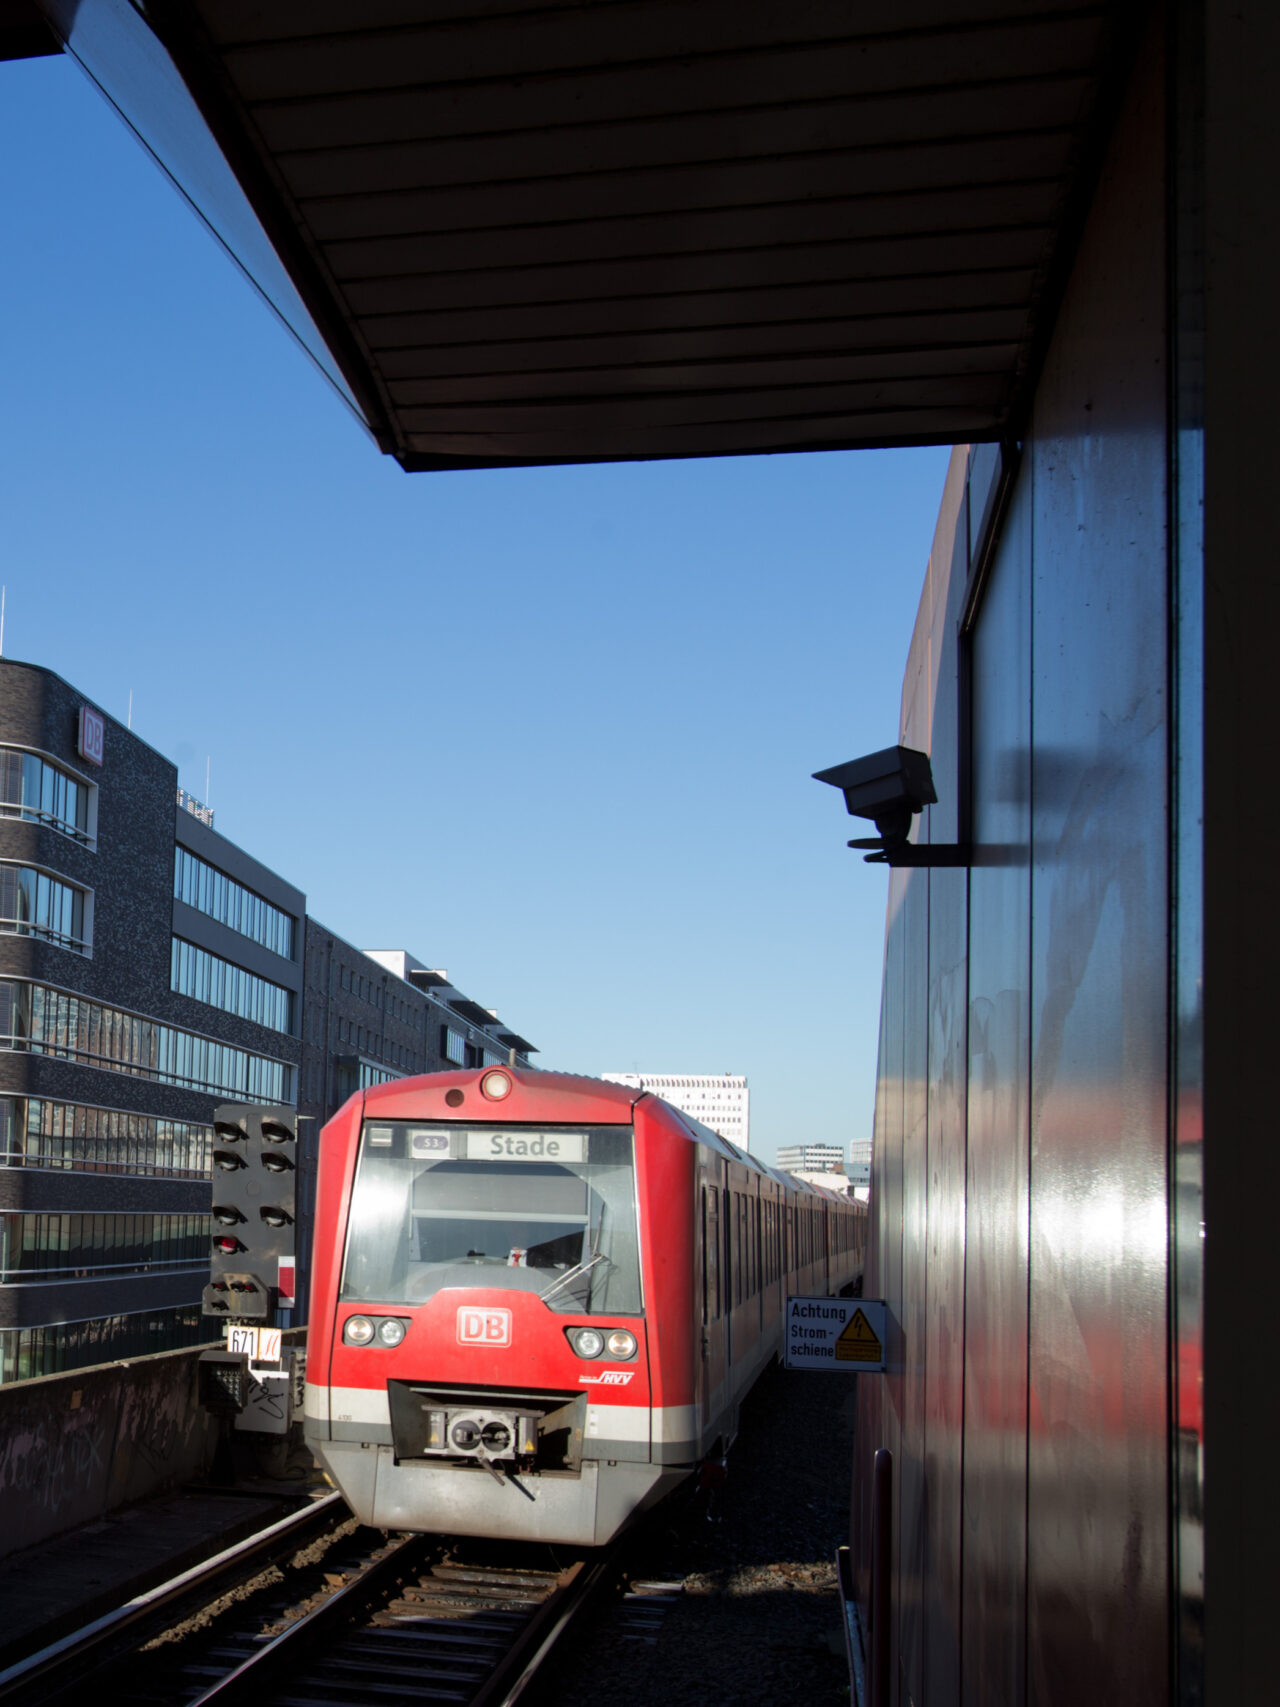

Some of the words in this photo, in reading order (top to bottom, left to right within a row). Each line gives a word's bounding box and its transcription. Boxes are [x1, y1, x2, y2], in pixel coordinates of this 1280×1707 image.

[86, 715, 102, 755] DB
[491, 1135, 560, 1157] Stade
[792, 1303, 846, 1323] Achtung
[465, 1315, 504, 1340] DB
[232, 1330, 254, 1356] 671
[791, 1343, 833, 1357] schiene
[603, 1374, 632, 1385] HVV
